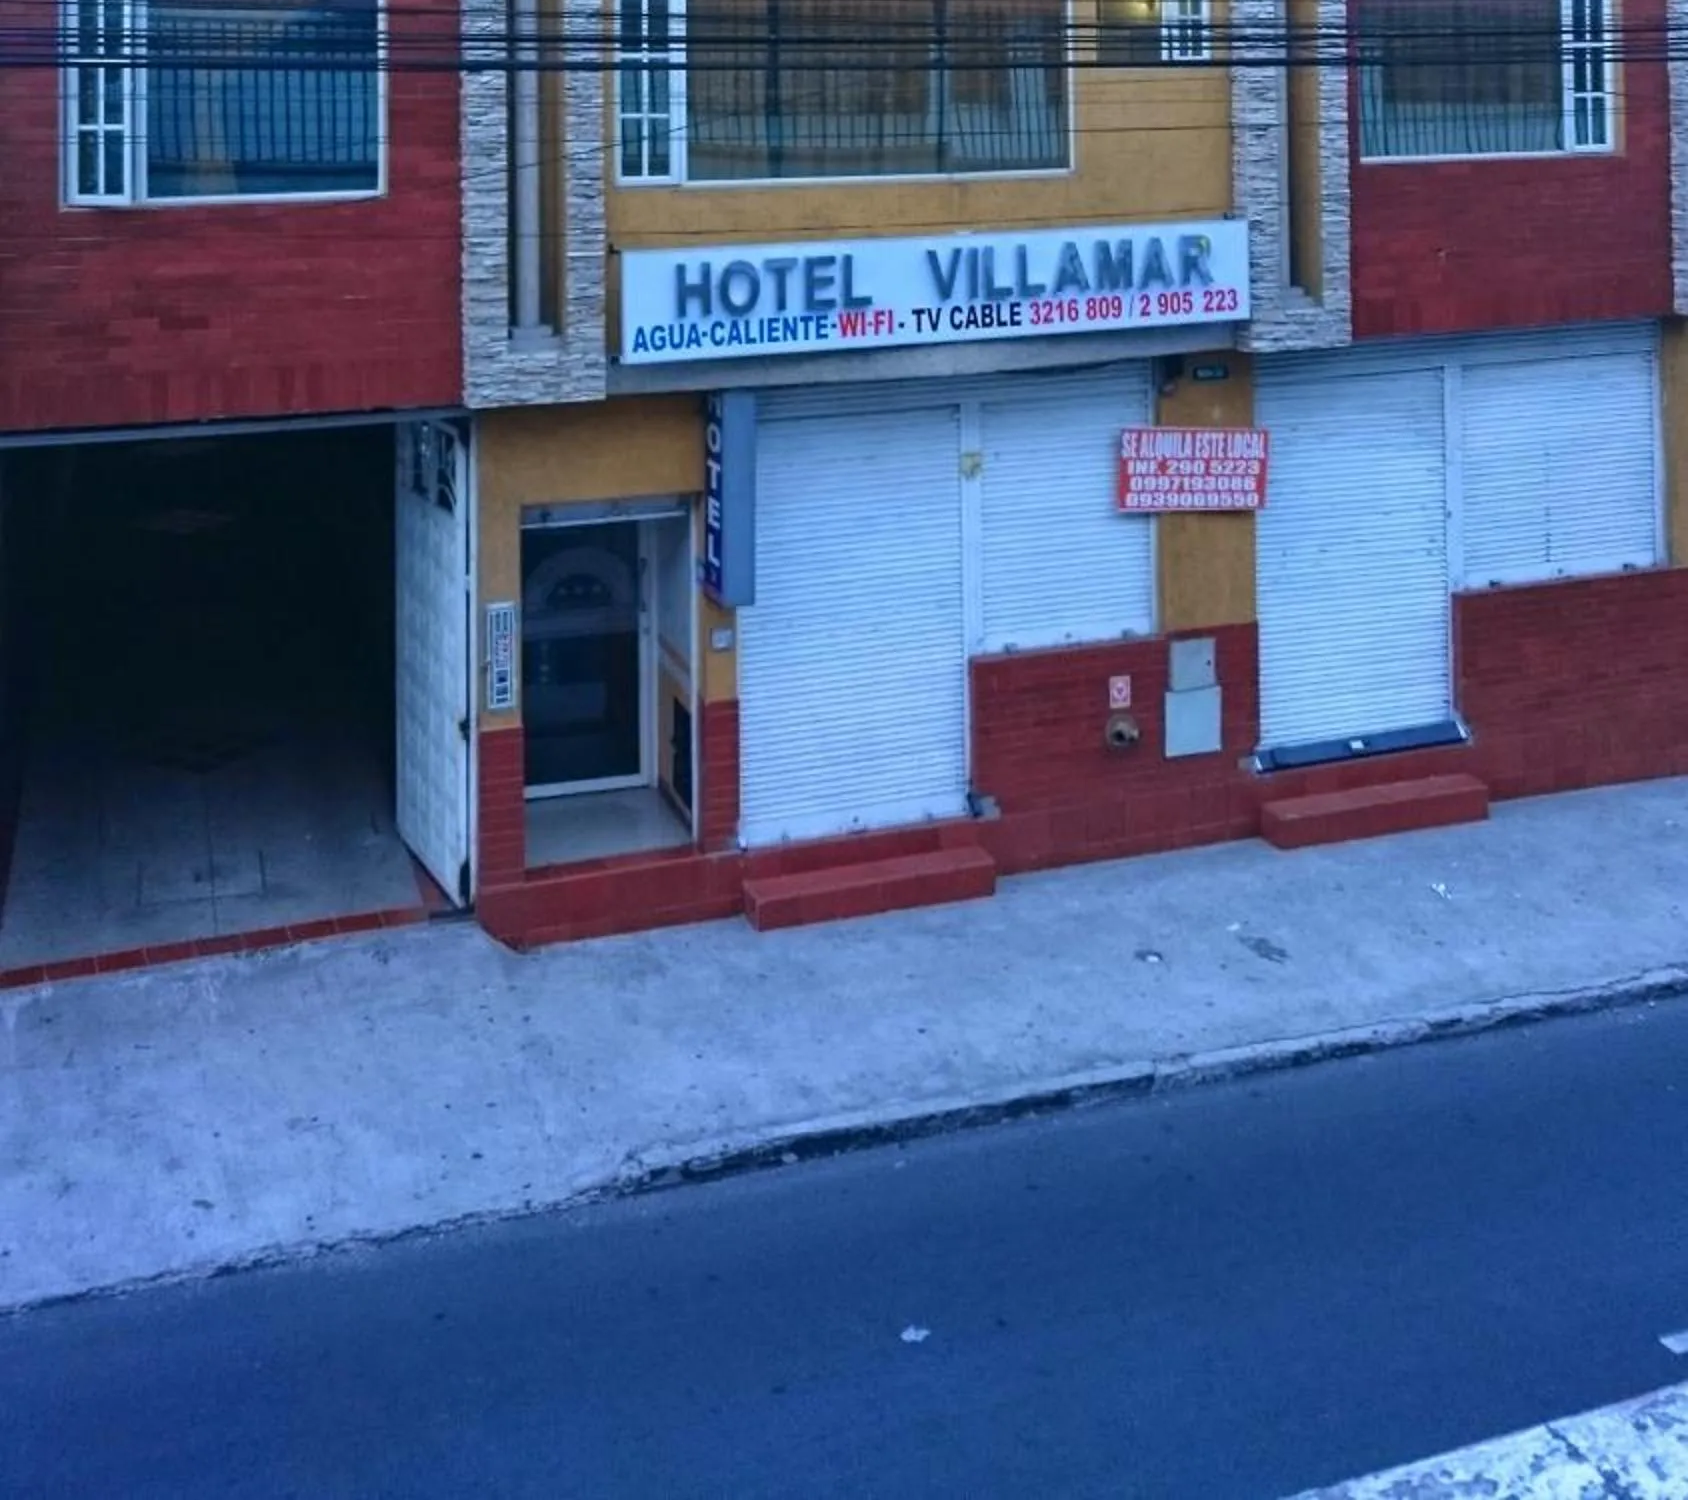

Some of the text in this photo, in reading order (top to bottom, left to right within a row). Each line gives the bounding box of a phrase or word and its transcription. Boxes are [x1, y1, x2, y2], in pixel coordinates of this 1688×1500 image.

[675, 235, 1214, 319] HOTEL VILLAMAR
[912, 308, 942, 333] TV
[951, 302, 1022, 330] CABLE
[1029, 297, 1079, 326] 3216
[1086, 295, 1122, 320] 809
[1158, 290, 1193, 315] 905
[1203, 288, 1238, 312] 223
[1121, 432, 1265, 460] SE ALQUILA ESTE LOCAL
[1165, 459, 1205, 475] 290
[1208, 459, 1261, 475] 5223
